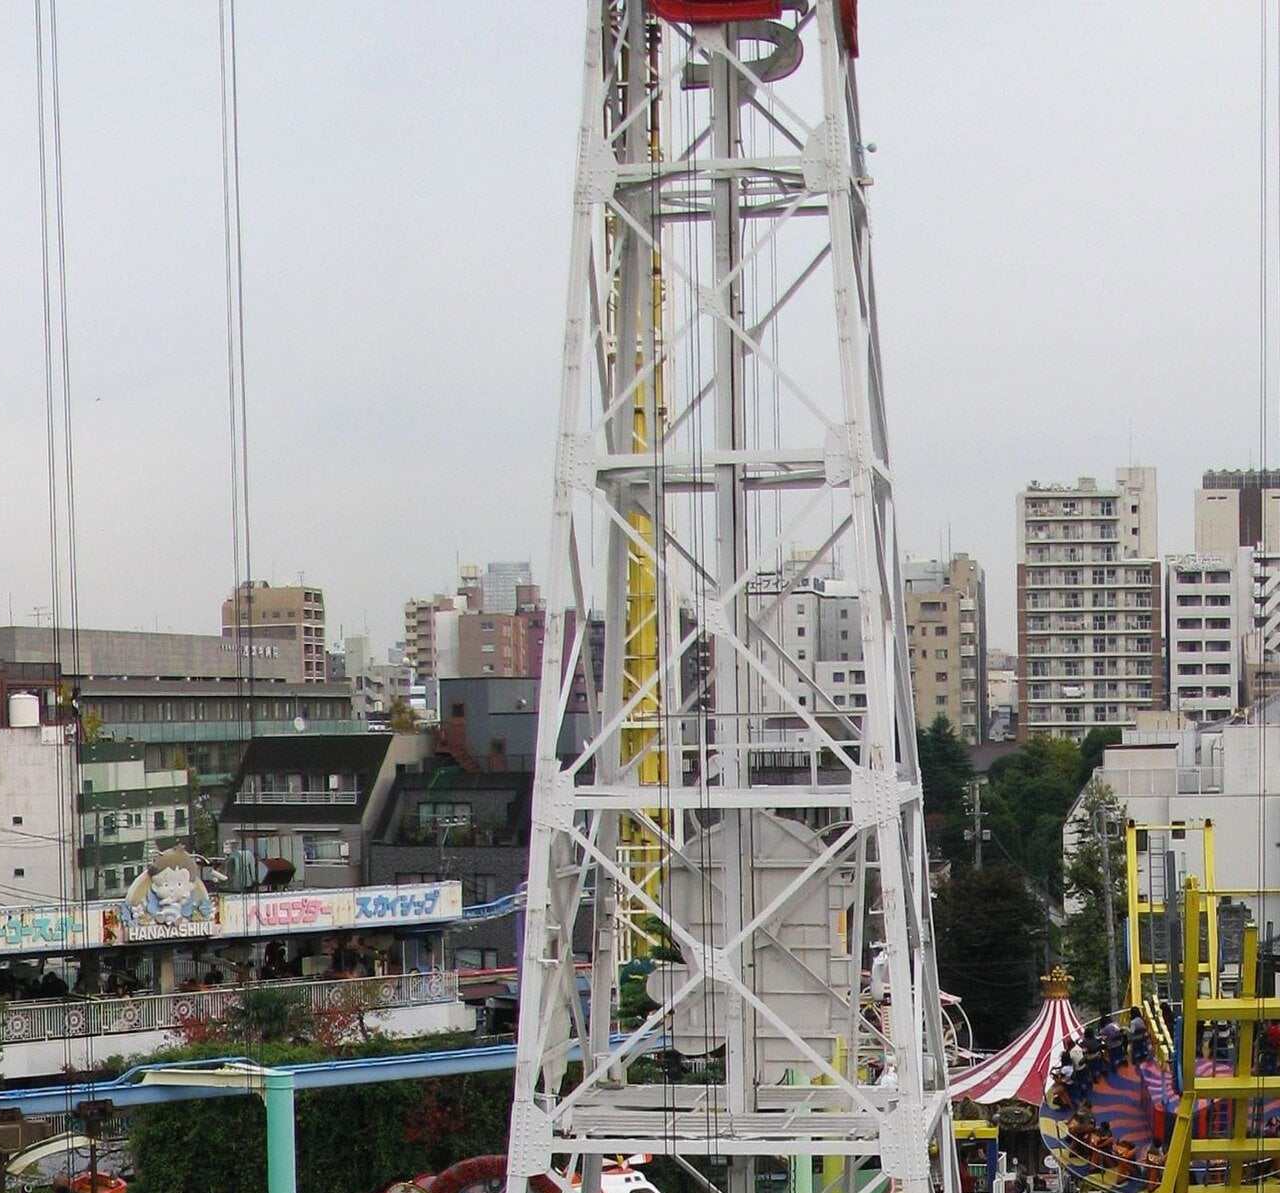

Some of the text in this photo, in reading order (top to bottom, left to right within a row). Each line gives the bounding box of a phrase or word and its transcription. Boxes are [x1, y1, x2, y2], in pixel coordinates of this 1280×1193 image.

[247, 898, 333, 926] ヘリコプター
[355, 889, 441, 919] スカイシップ
[129, 921, 214, 942] HANAYASHIKI
